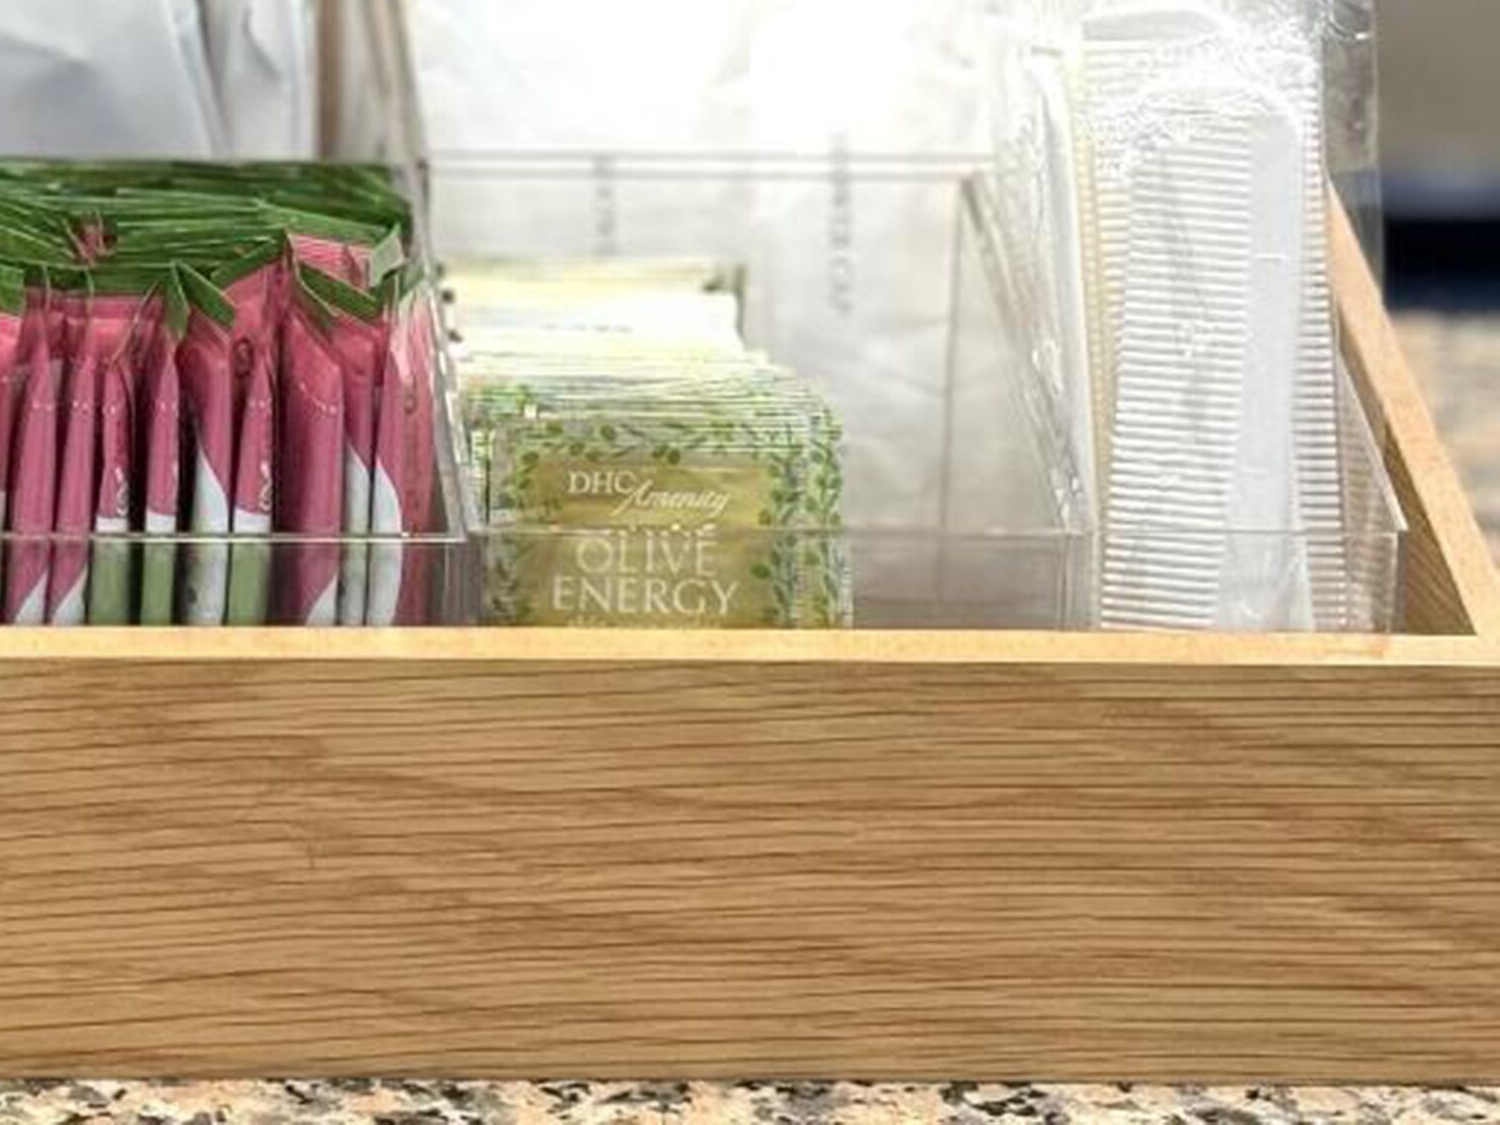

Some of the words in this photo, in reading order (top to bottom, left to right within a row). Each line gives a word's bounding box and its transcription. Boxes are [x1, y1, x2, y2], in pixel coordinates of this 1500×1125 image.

[568, 470, 635, 495] DHC
[612, 479, 732, 518] Amenity
[575, 531, 721, 577] OLIVE
[551, 575, 740, 616] ENERGY
